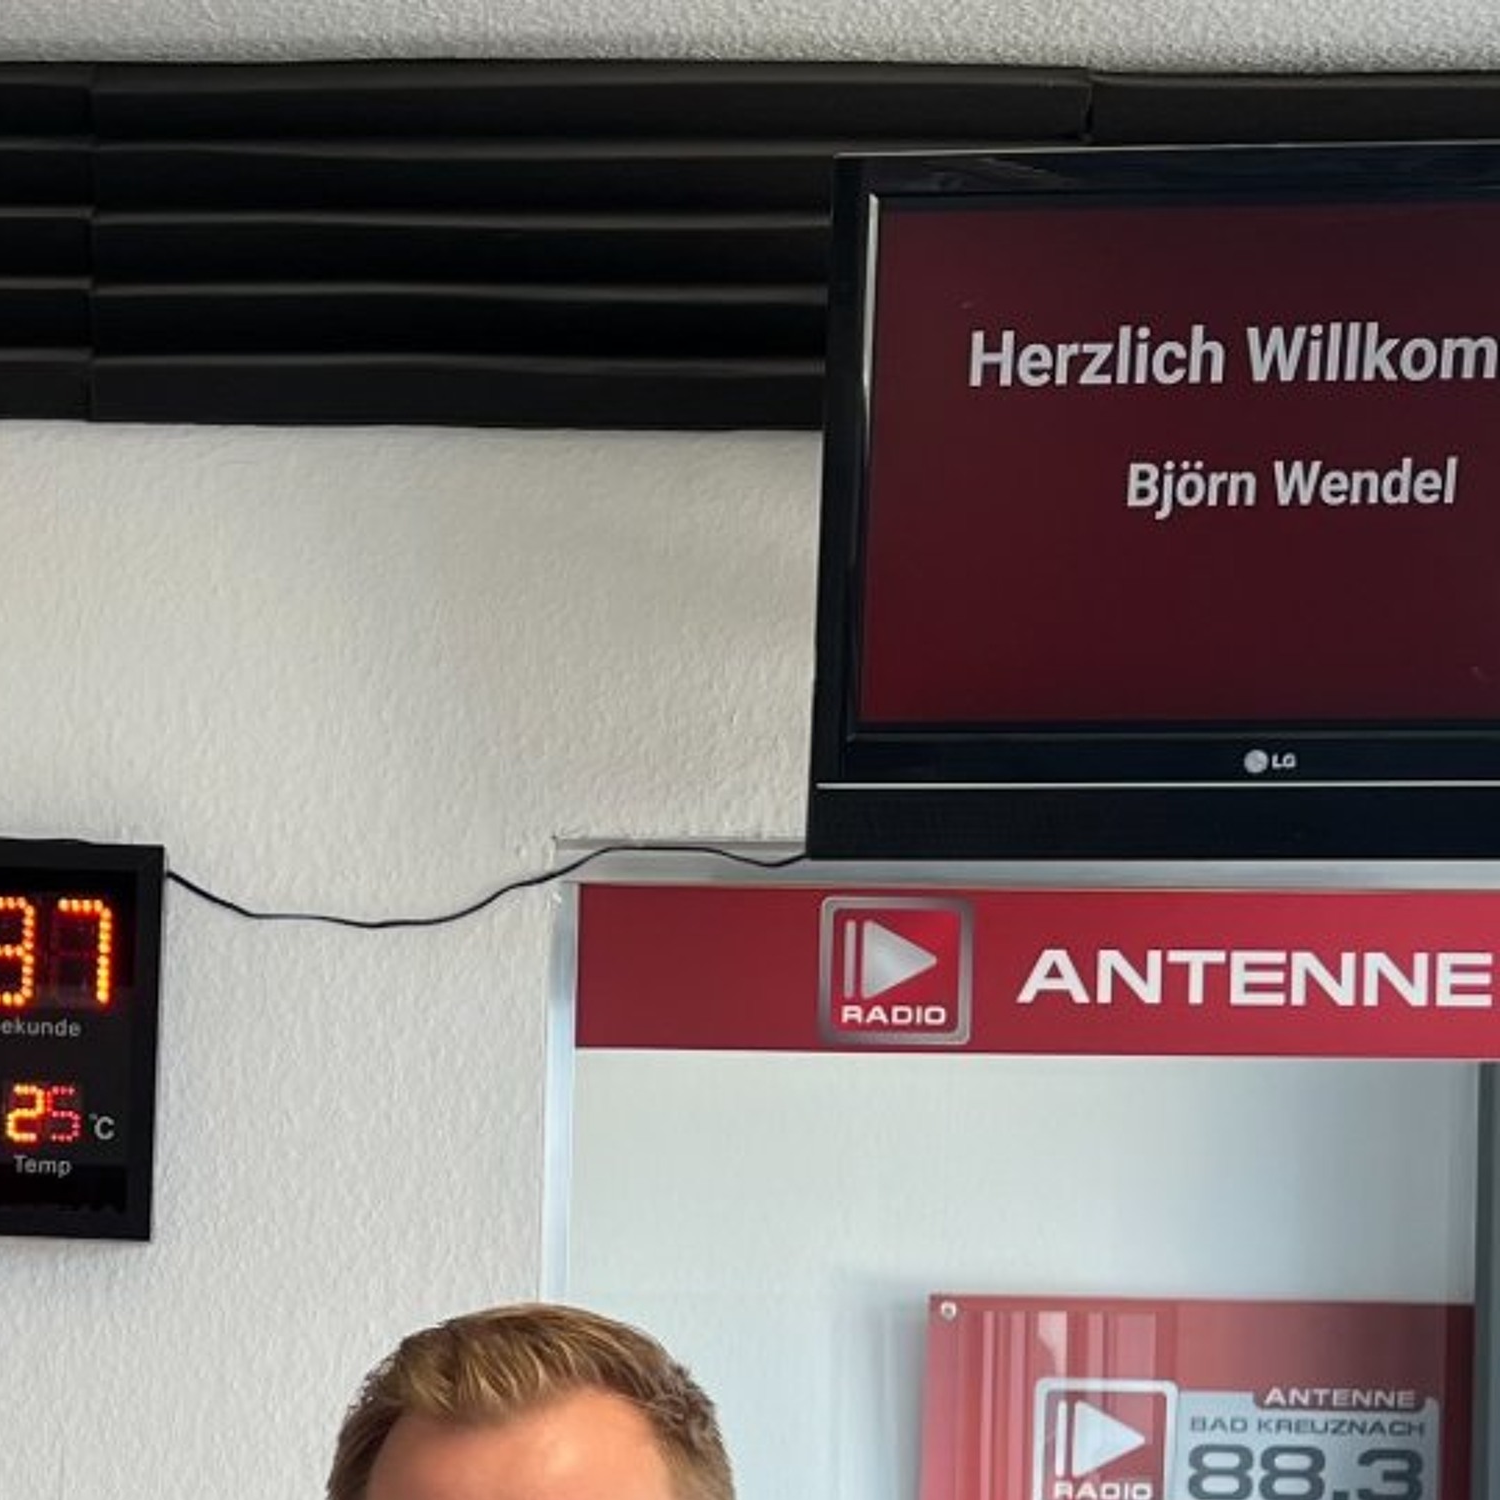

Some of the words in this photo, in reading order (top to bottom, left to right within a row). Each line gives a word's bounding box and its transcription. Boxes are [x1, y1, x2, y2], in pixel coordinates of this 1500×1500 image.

[968, 325, 1225, 387] Herzlich
[1247, 320, 1498, 382] Willkom
[1127, 460, 1257, 520] Björn
[1274, 457, 1457, 506] Wendel
[1271, 752, 1296, 769] LG
[1016, 949, 1493, 1007] ANTENNE
[841, 1005, 947, 1027] RADIO
[14, 1155, 73, 1179] Temp
[1263, 1387, 1417, 1410] ANTENNE
[1189, 1416, 1249, 1434] BAD
[1256, 1417, 1426, 1437] KREUZNACH
